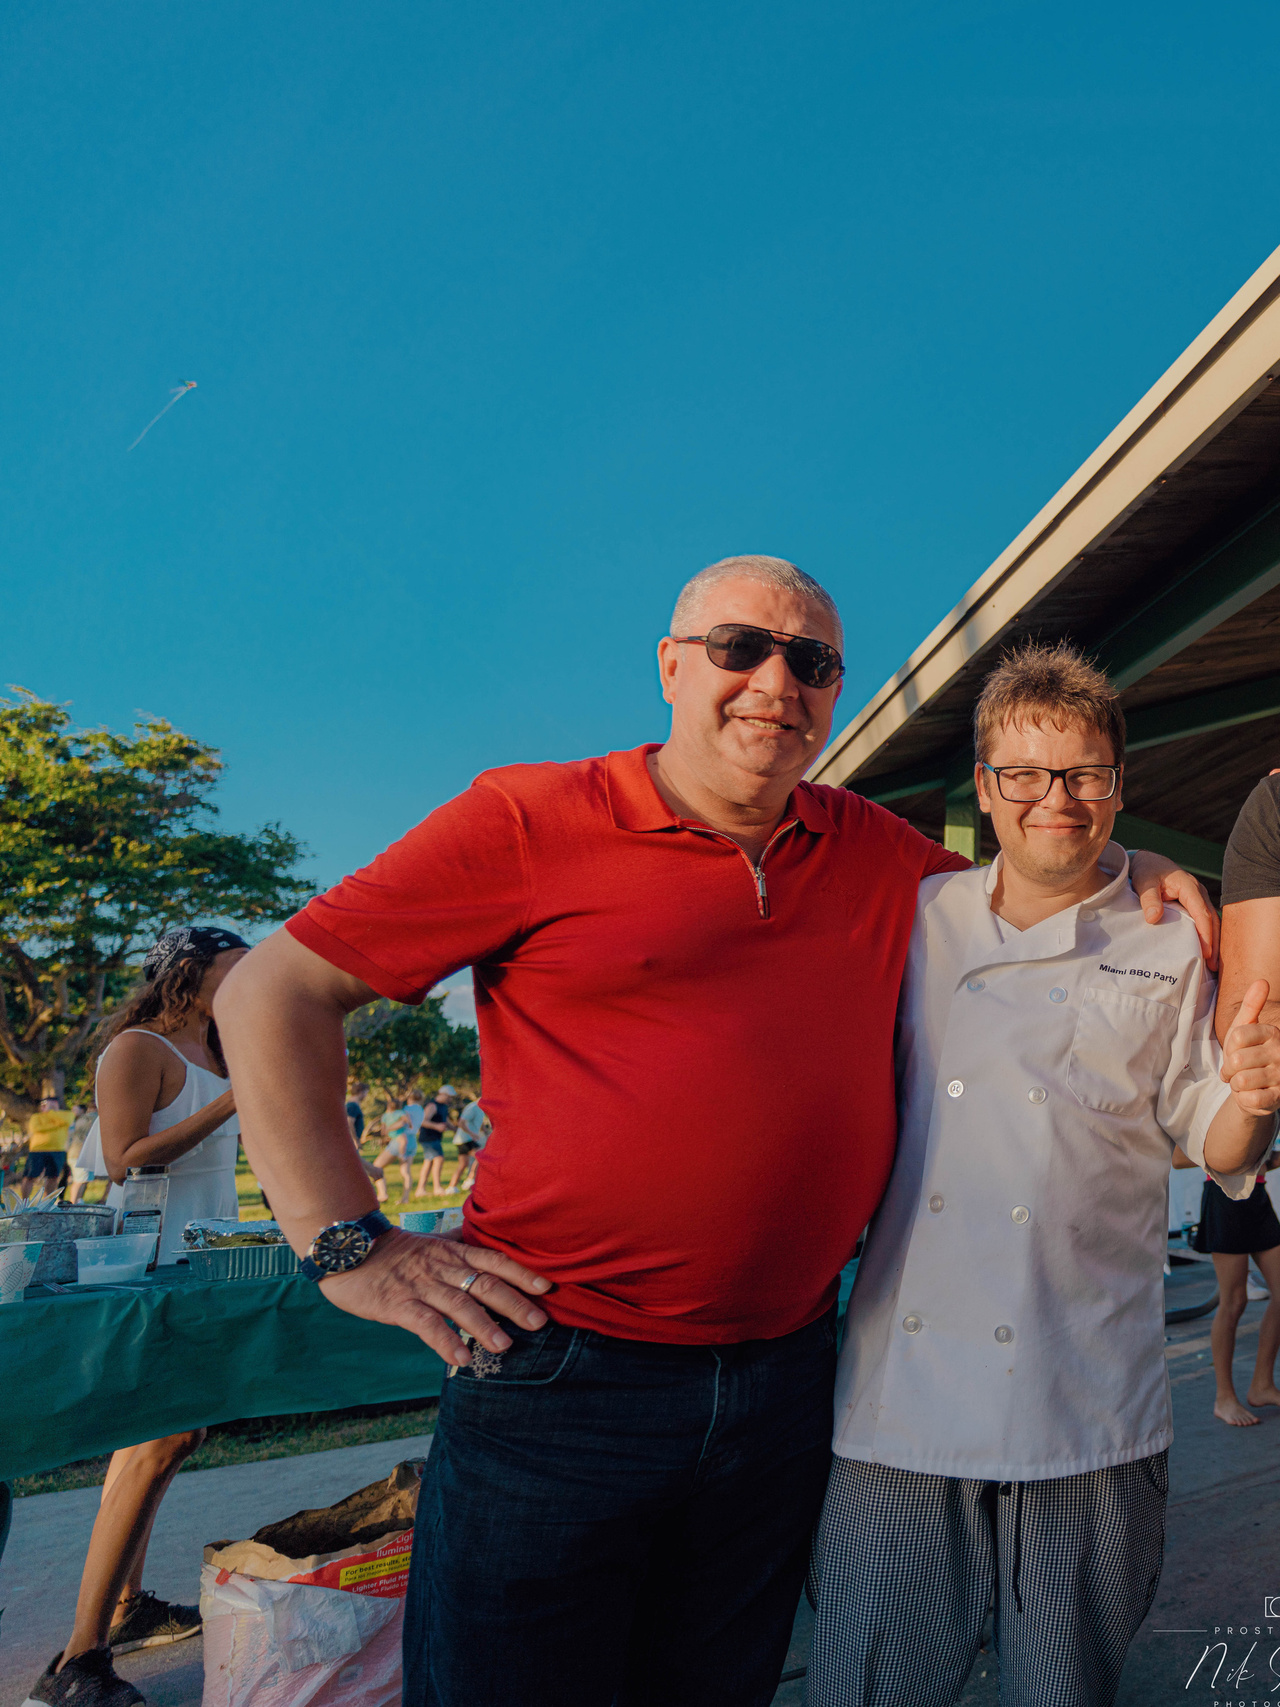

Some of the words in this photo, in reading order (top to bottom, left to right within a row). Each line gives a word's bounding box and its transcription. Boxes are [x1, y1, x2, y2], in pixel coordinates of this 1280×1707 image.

[1099, 964, 1127, 975] Miami
[1129, 969, 1151, 979] BBQ
[1153, 971, 1178, 985] Party
[345, 1569, 358, 1577] For
[359, 1564, 374, 1573] best
[375, 1559, 401, 1569] results,
[352, 1582, 377, 1593] Lighter
[379, 1575, 397, 1585] Fluid
[380, 1583, 399, 1592] Fluido
